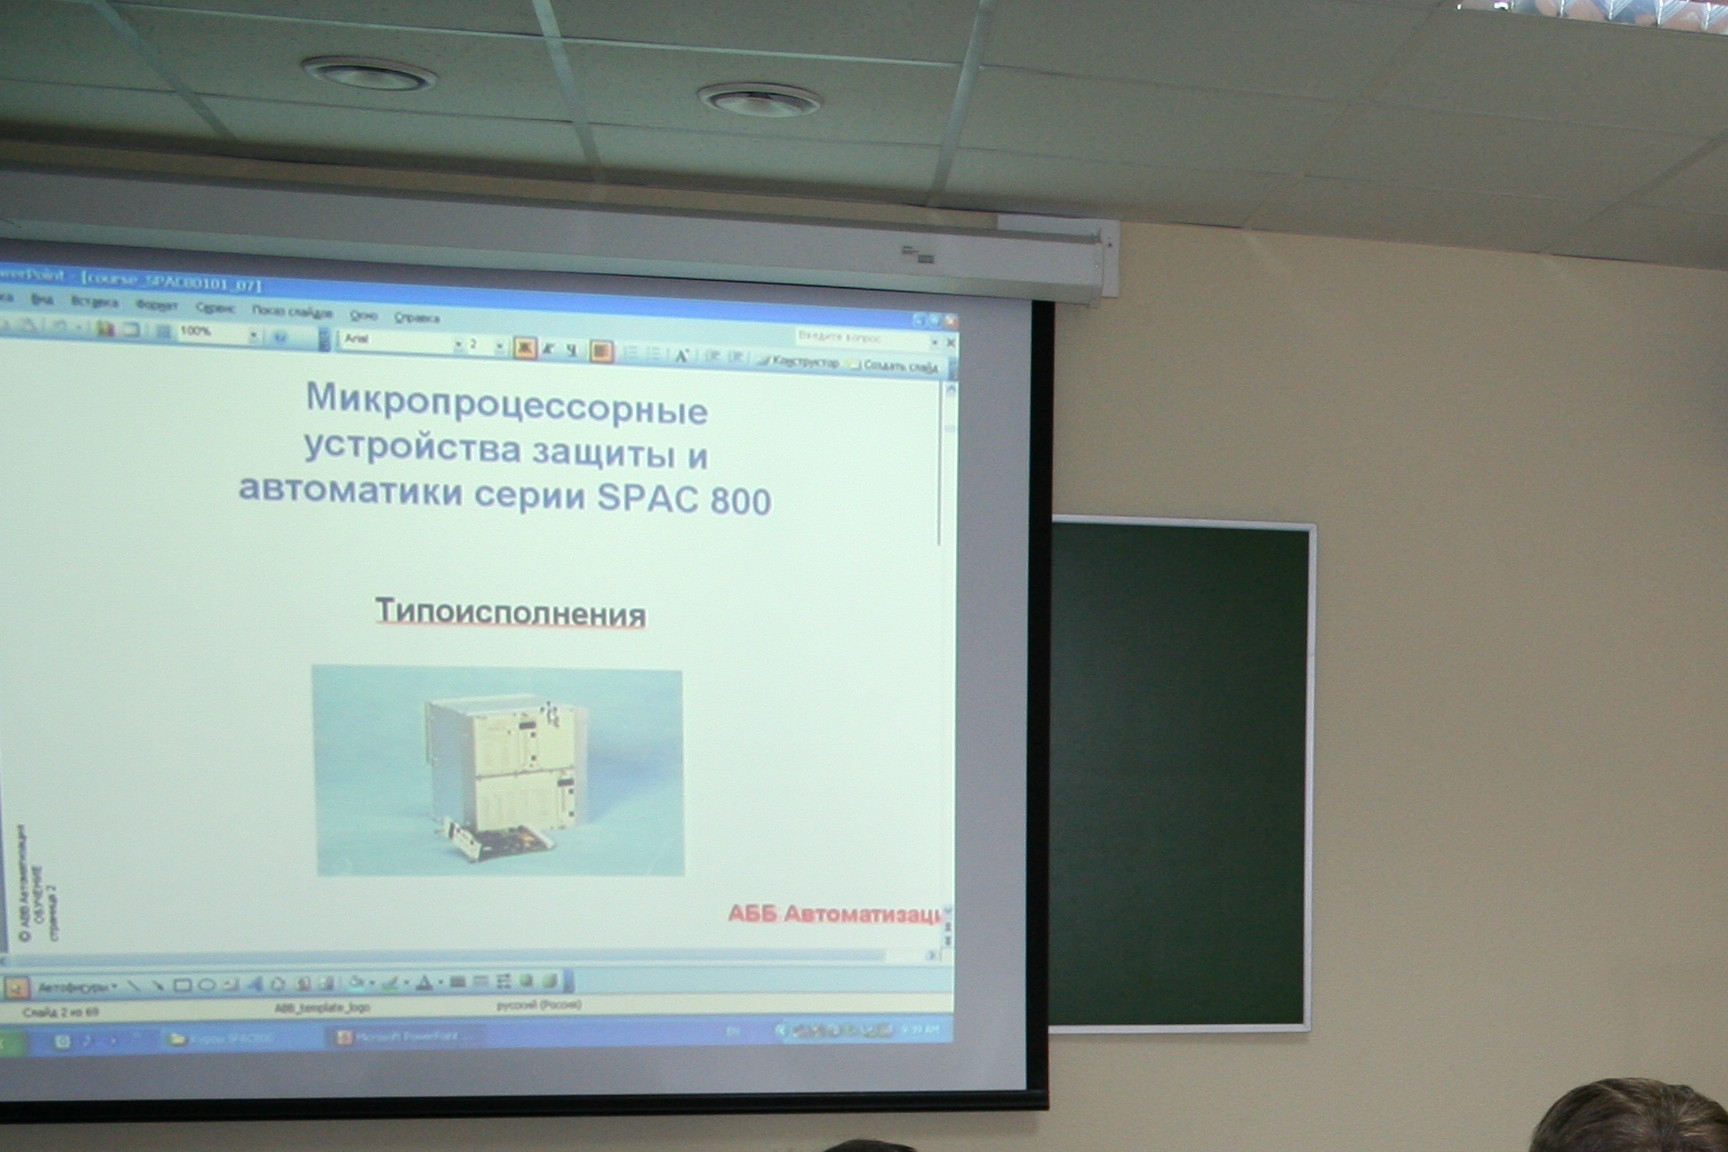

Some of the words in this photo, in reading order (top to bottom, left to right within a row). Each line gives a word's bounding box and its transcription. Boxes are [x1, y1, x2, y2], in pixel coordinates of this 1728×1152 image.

[306, 380, 708, 428] Микропроцессорные
[304, 430, 521, 465] устройства
[532, 442, 675, 470] защиты
[689, 448, 707, 469] и
[239, 477, 462, 506] автоматики
[475, 484, 585, 514] серии
[598, 483, 699, 513] SPAC
[711, 487, 772, 516] 800
[375, 596, 646, 627] Типоисполнения
[729, 904, 778, 922] АББ
